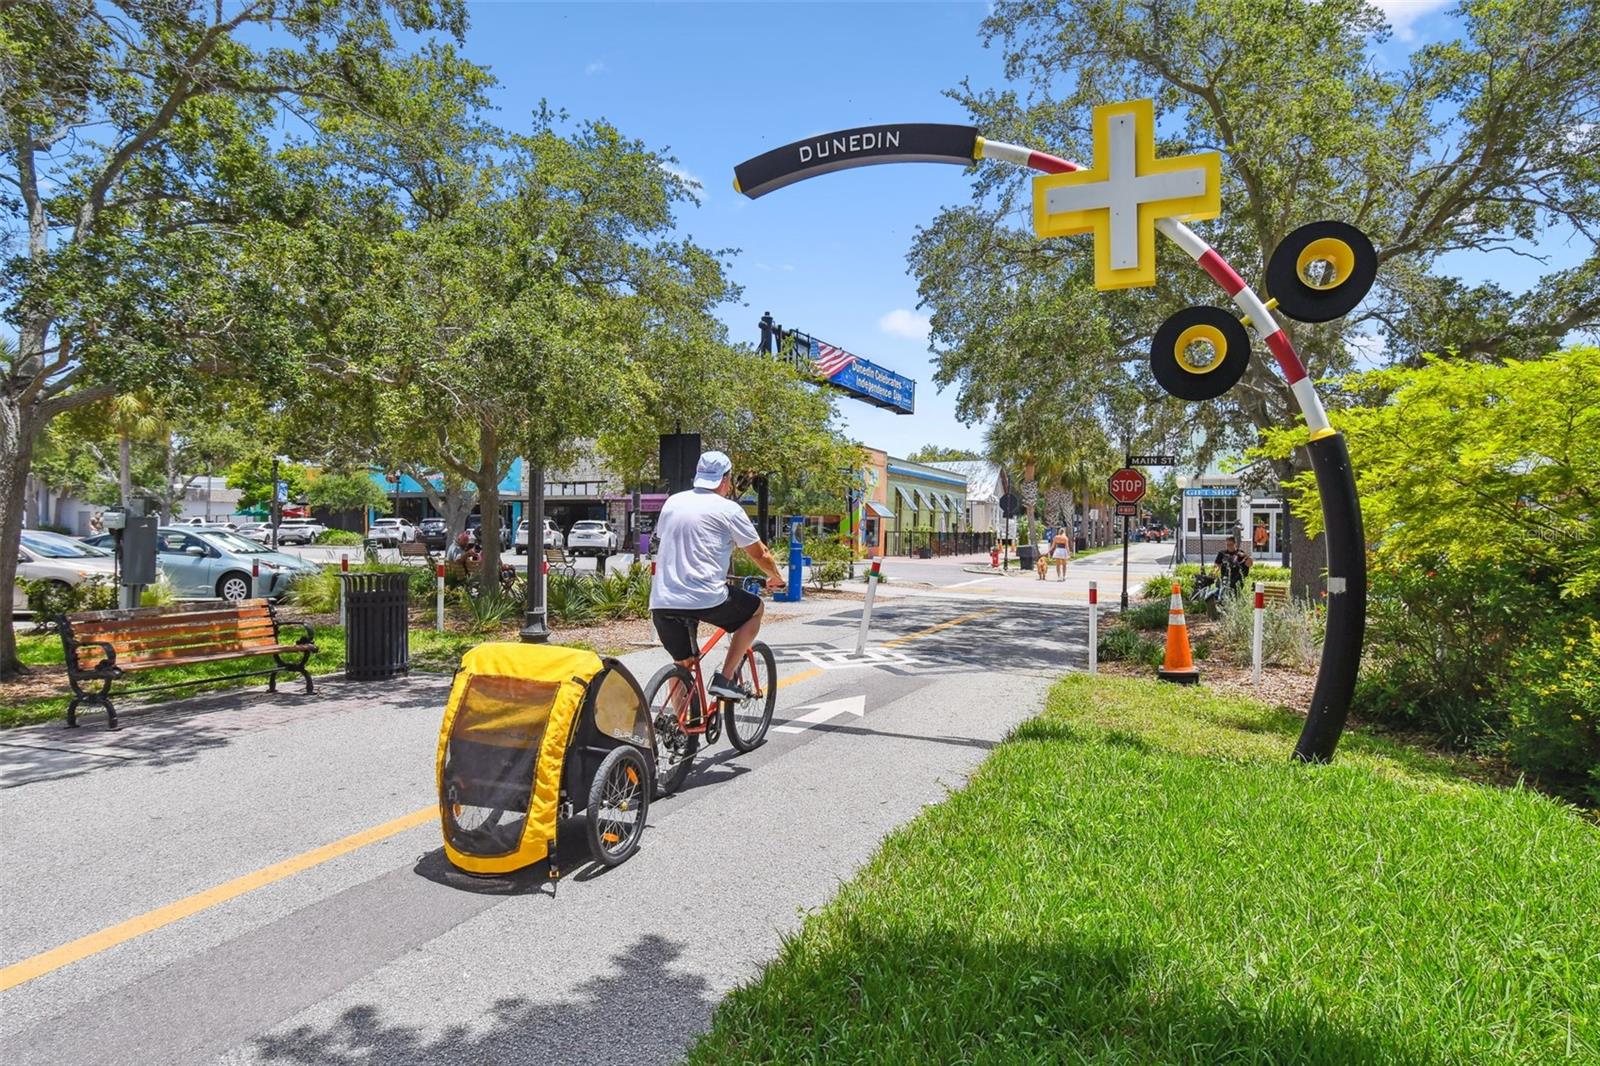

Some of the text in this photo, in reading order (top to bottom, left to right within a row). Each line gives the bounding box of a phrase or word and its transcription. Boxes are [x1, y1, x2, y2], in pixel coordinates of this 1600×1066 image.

[799, 131, 900, 163] DUNEDIN
[852, 360, 902, 389] Dunedin Celebrates
[856, 375, 892, 398] Independence
[1132, 457, 1173, 465] MAIN ST
[1112, 479, 1142, 493] STOP
